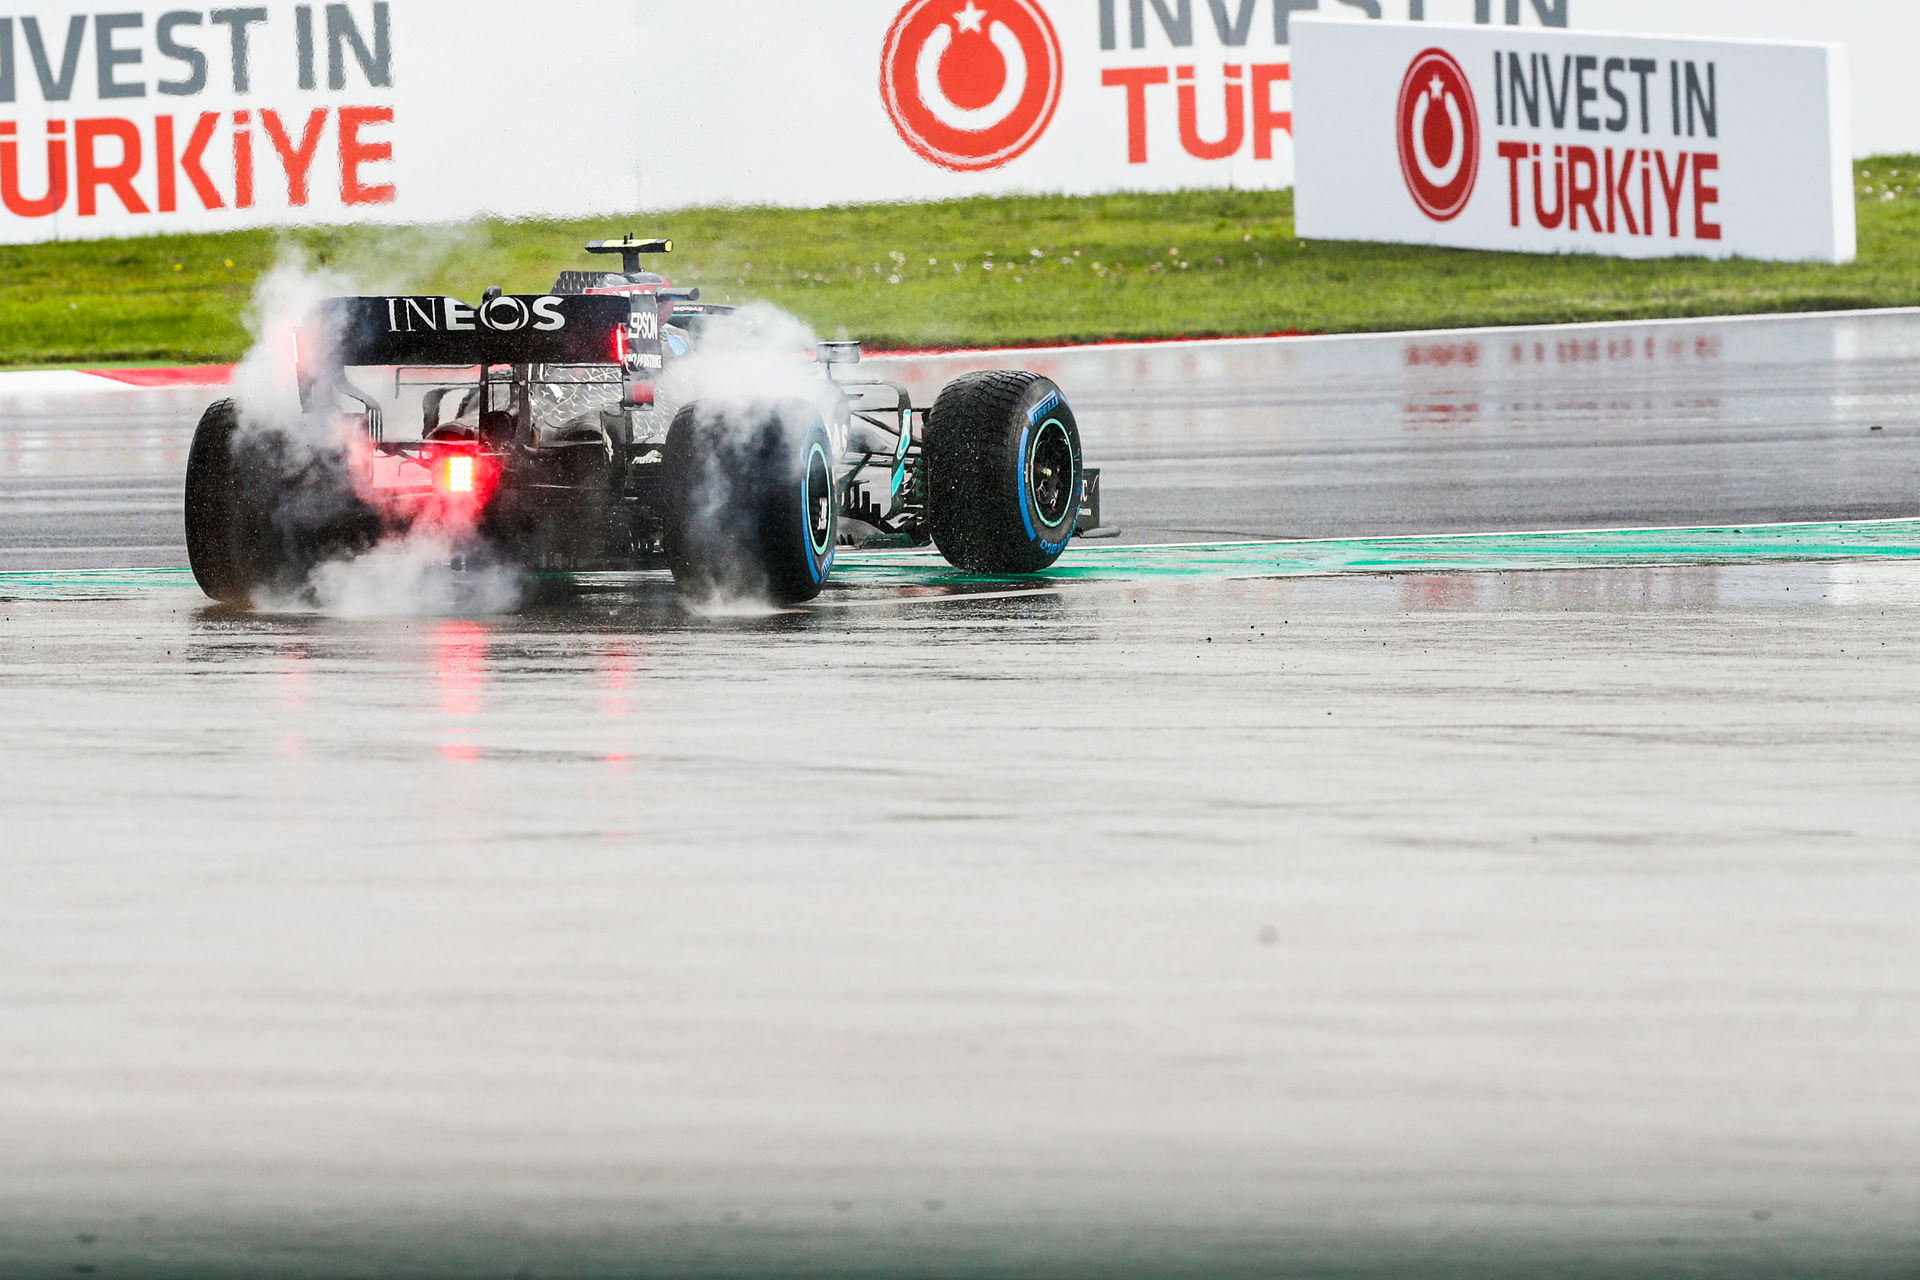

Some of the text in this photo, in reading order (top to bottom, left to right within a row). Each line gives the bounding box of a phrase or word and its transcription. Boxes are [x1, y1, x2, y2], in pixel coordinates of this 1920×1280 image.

[0, 0, 393, 103] VEST IN
[1494, 50, 1718, 138] INVEST IN
[385, 296, 566, 332] INEOS
[627, 311, 659, 340] EPSON
